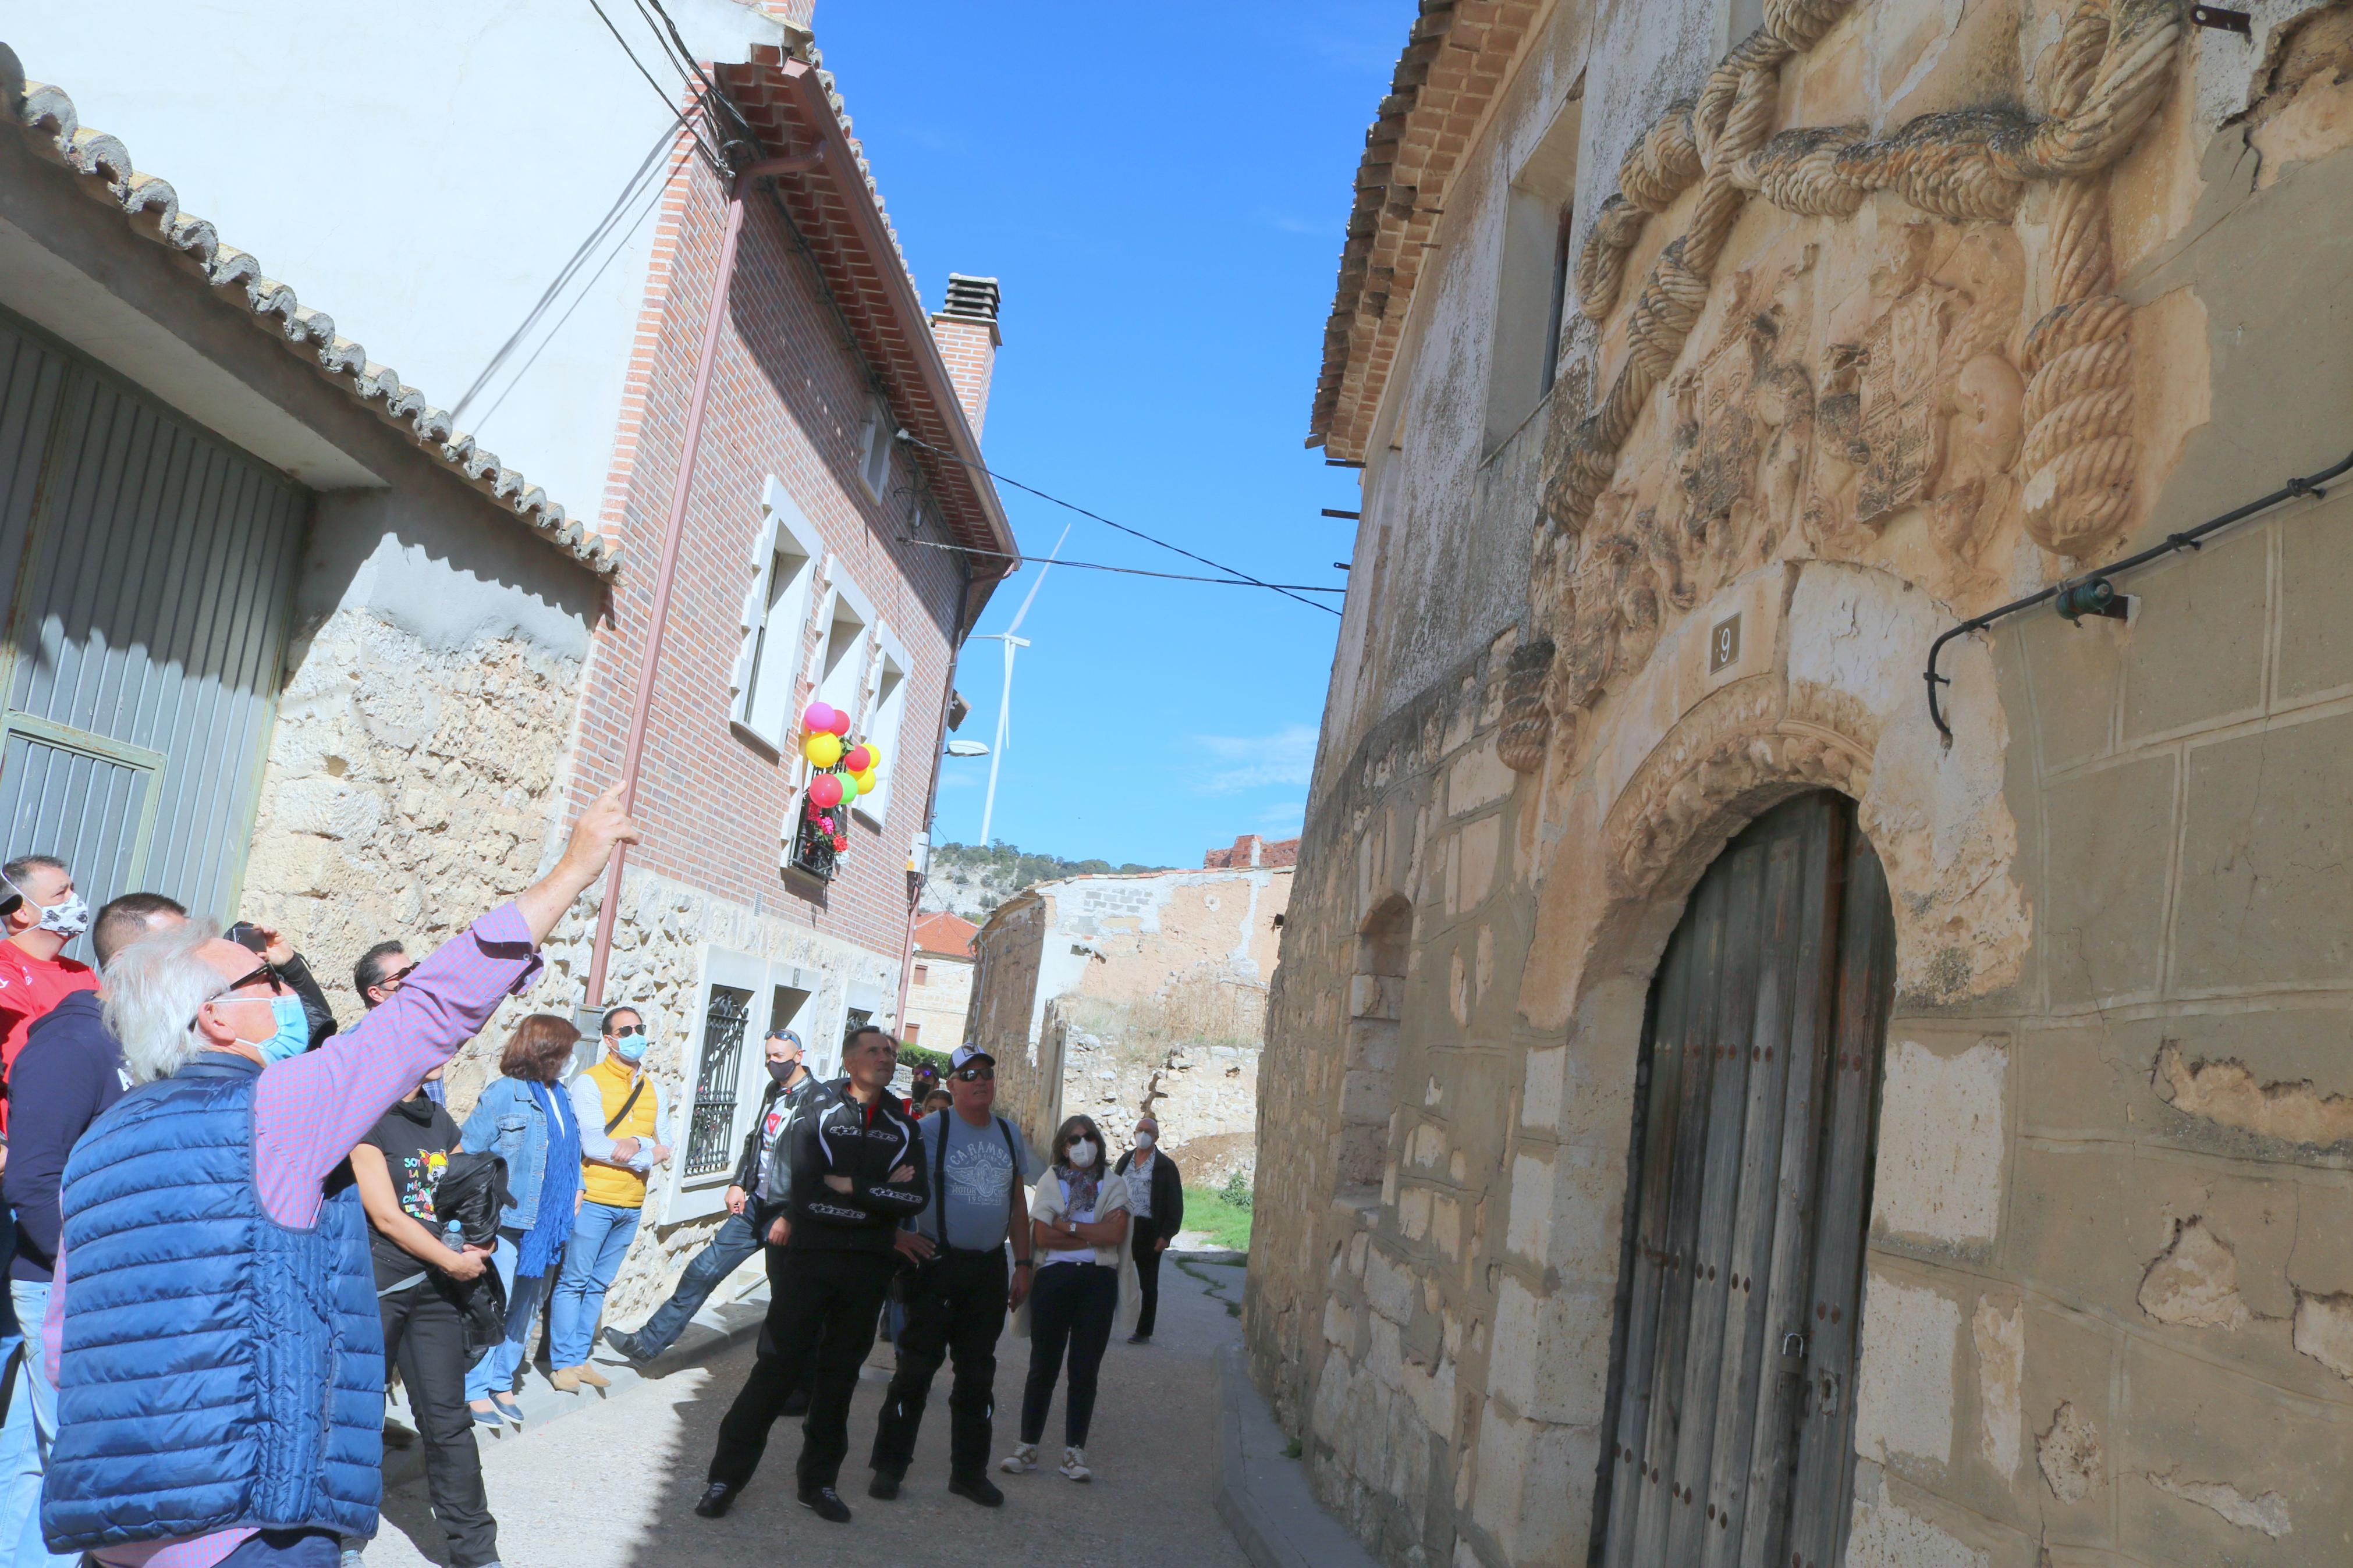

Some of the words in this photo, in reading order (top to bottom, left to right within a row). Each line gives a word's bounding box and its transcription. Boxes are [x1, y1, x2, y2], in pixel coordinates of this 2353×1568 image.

[1720, 628, 1730, 663] 9
[404, 1157, 421, 1168] SOY
[409, 1169, 419, 1178] LA
[869, 1187, 922, 1203] alpinestars
[952, 1186, 977, 1194] MOTOR
[404, 1204, 420, 1213] DEL
[808, 1203, 866, 1219] alpinestars
